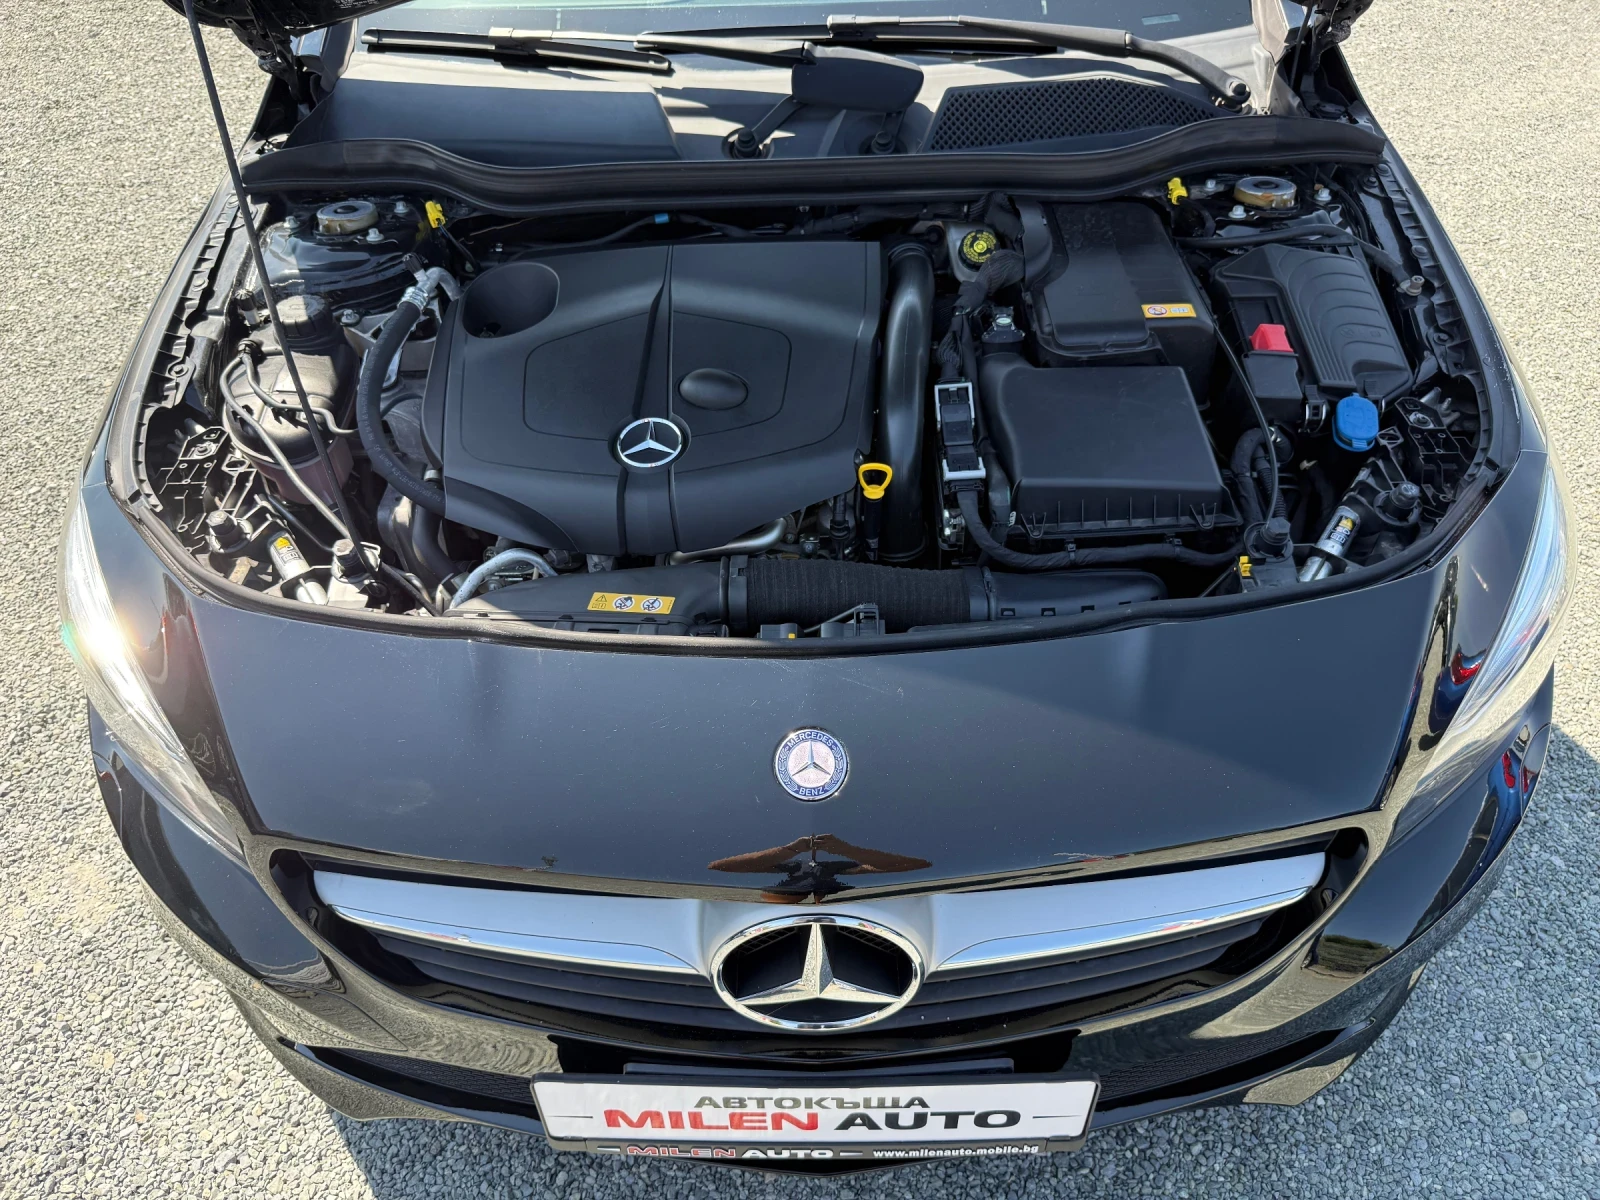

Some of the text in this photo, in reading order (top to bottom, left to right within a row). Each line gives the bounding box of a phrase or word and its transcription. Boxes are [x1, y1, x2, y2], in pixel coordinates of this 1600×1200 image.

[787, 731, 834, 748] MERCEDES
[799, 786, 825, 796] BENZ
[694, 1096, 931, 1110] АВТОКЪША
[603, 1109, 1021, 1131] MILEN AUTO
[626, 1144, 1039, 1159] MILEN AUTO www.milenauto.mobile.bg
